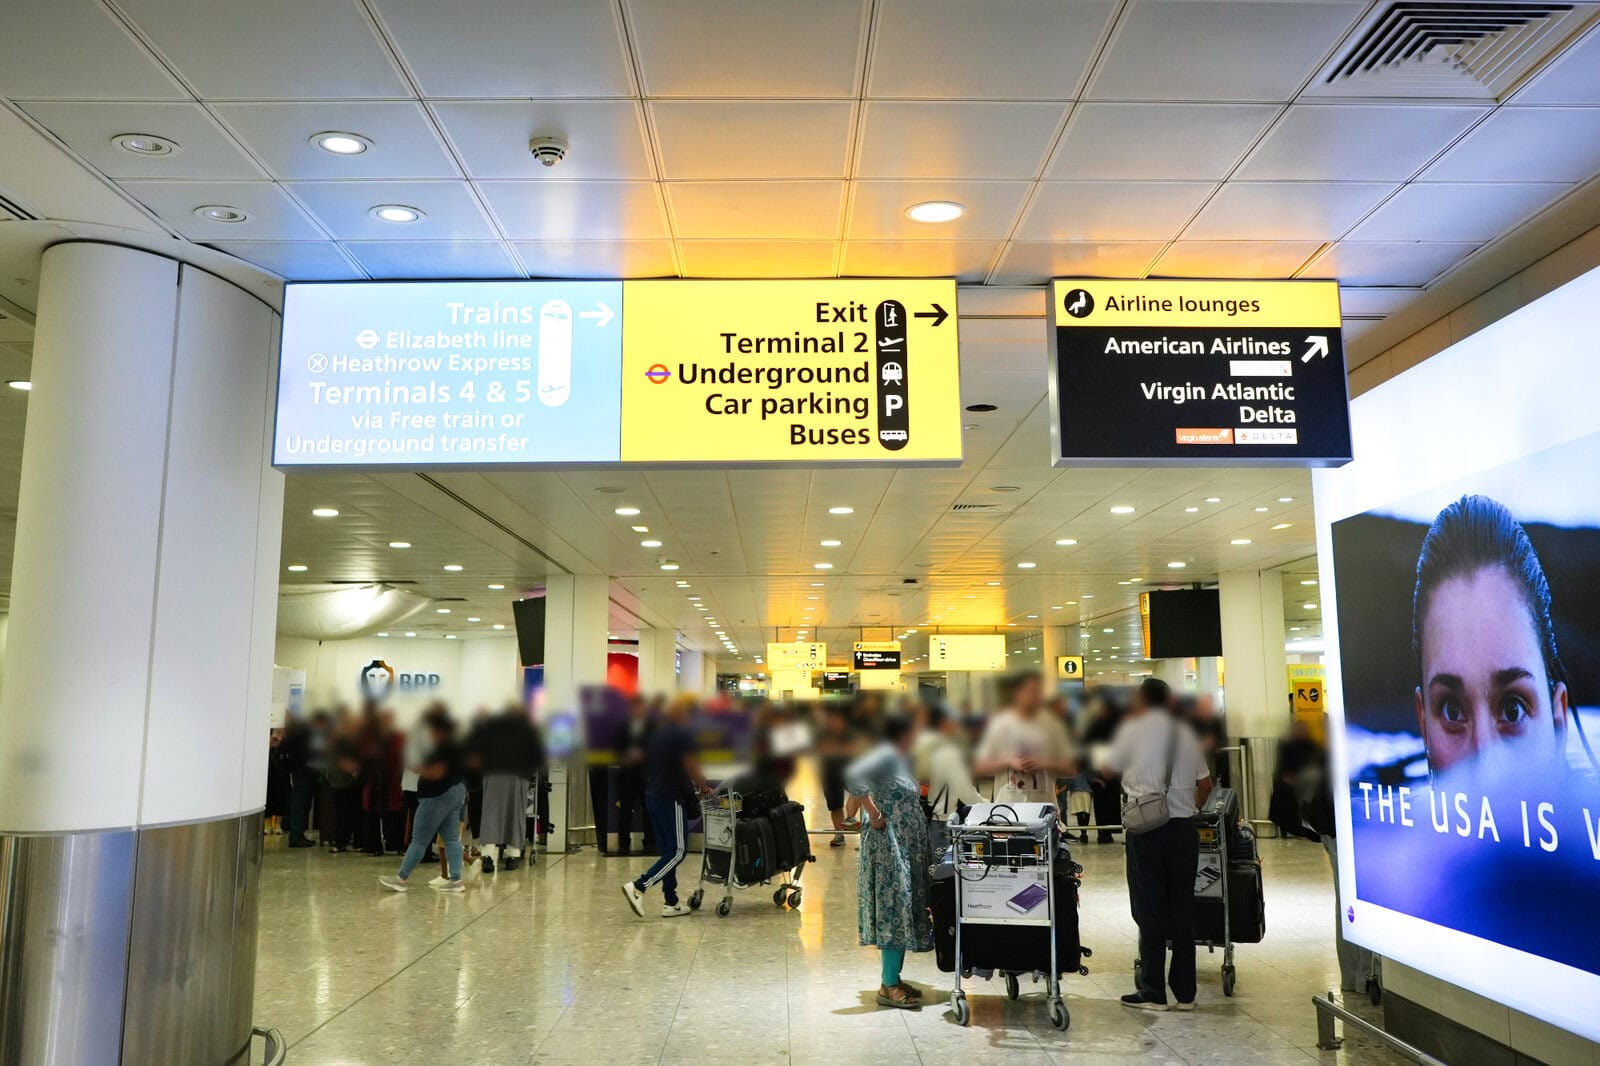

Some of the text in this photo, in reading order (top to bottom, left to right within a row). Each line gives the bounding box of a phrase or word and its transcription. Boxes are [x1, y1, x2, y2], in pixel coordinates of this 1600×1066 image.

[447, 301, 533, 324] Trains
[816, 302, 867, 322] Exit
[1105, 296, 1260, 316] Airline lounges
[386, 330, 533, 348] Elizabeth line
[720, 332, 868, 353] Terminal 2
[1104, 337, 1291, 355] American Airlines
[332, 354, 532, 376] Heathrow Express
[678, 362, 869, 389] Underground
[309, 380, 531, 405] Terminals 4 & 5
[1141, 382, 1295, 404] Virgin Atlantic
[705, 392, 869, 420] Car parking
[1240, 406, 1296, 423] Delta
[352, 411, 524, 429] via Free train or
[286, 433, 529, 457] Underground transfer
[790, 424, 870, 446] Buses
[1252, 432, 1293, 440] DELTA
[1359, 782, 1414, 827] THE
[1429, 790, 1500, 842] USA
[1520, 800, 1559, 852] IS
